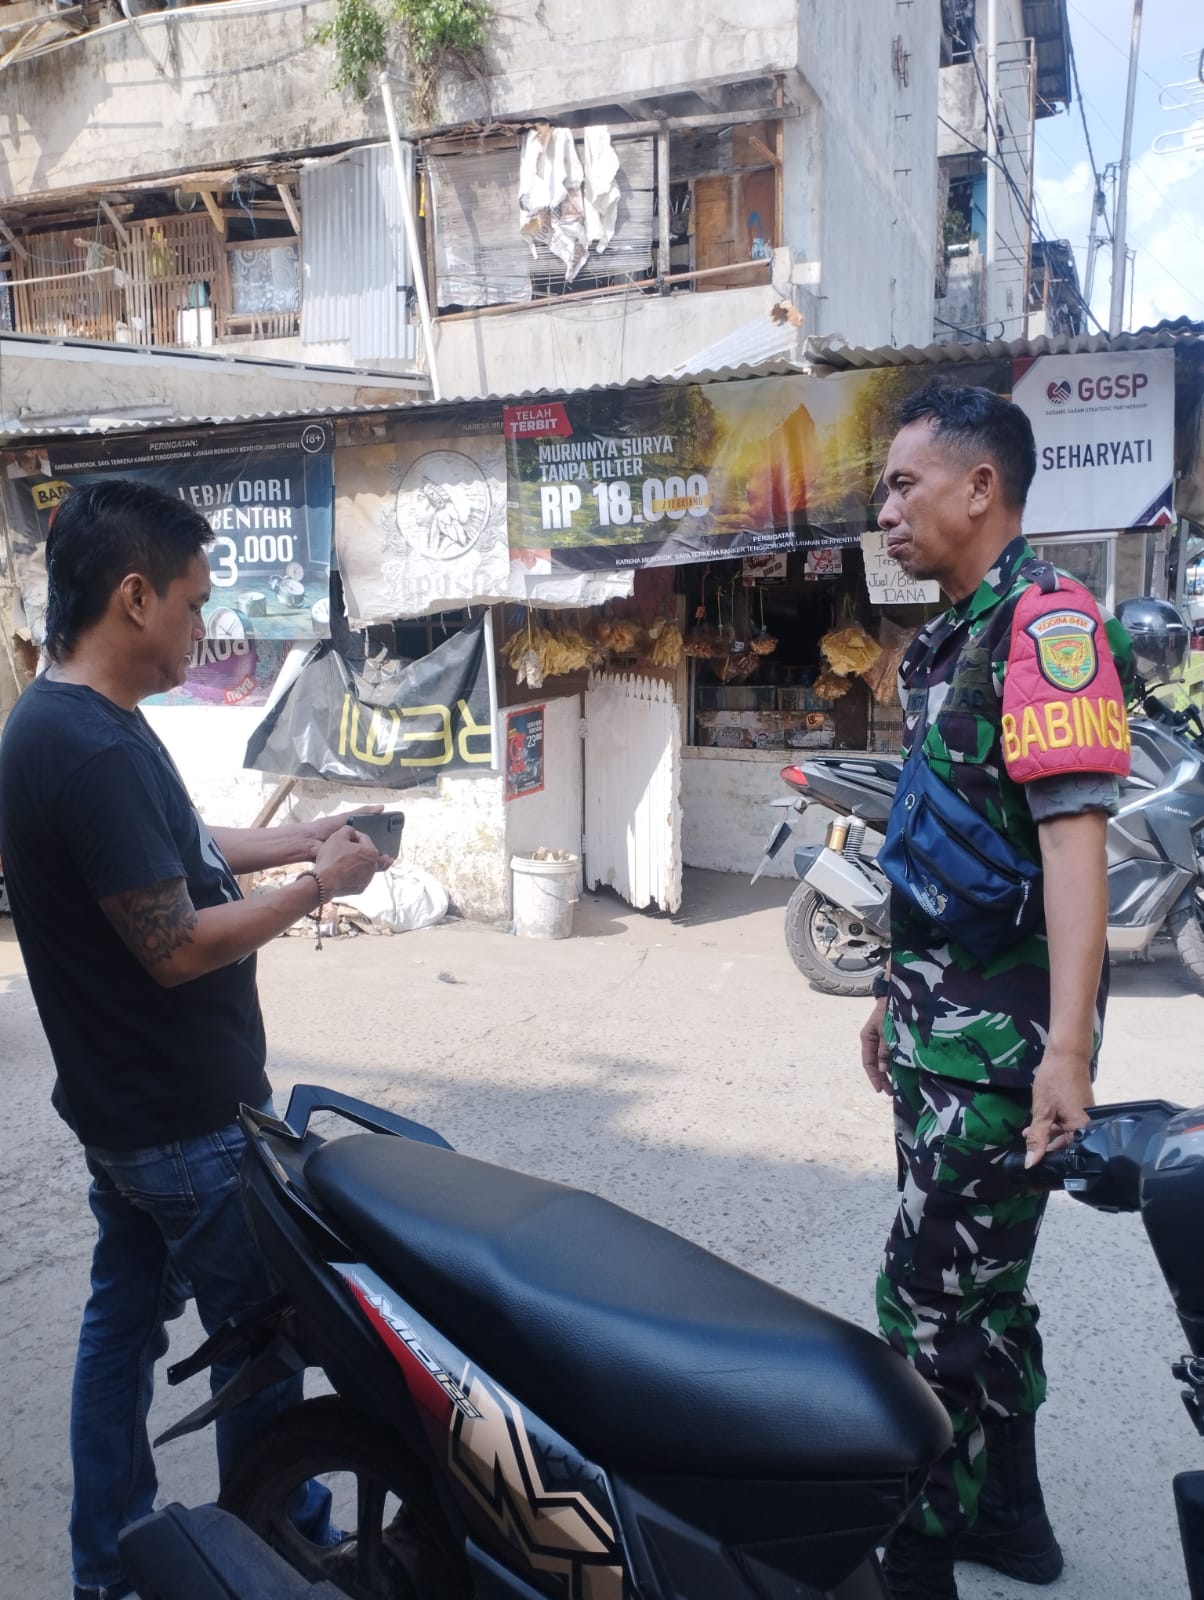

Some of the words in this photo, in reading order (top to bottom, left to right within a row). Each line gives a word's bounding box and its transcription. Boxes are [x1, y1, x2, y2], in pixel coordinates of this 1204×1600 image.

[1078, 373, 1149, 402] GGSP
[510, 418, 558, 433] TERBIT
[515, 408, 552, 420] TELAH
[305, 434, 322, 445] 18+
[539, 440, 618, 464] MURNINYA
[622, 435, 674, 456] SURYA
[1042, 439, 1152, 471] SEHARYATI
[540, 462, 589, 482] TANPA
[593, 458, 644, 479] FILTER
[239, 478, 291, 502] DARI
[540, 485, 582, 530] RP
[593, 474, 710, 526] 18.000
[874, 554, 900, 569] Ters
[883, 588, 927, 603] DANA
[226, 676, 255, 703] BARU
